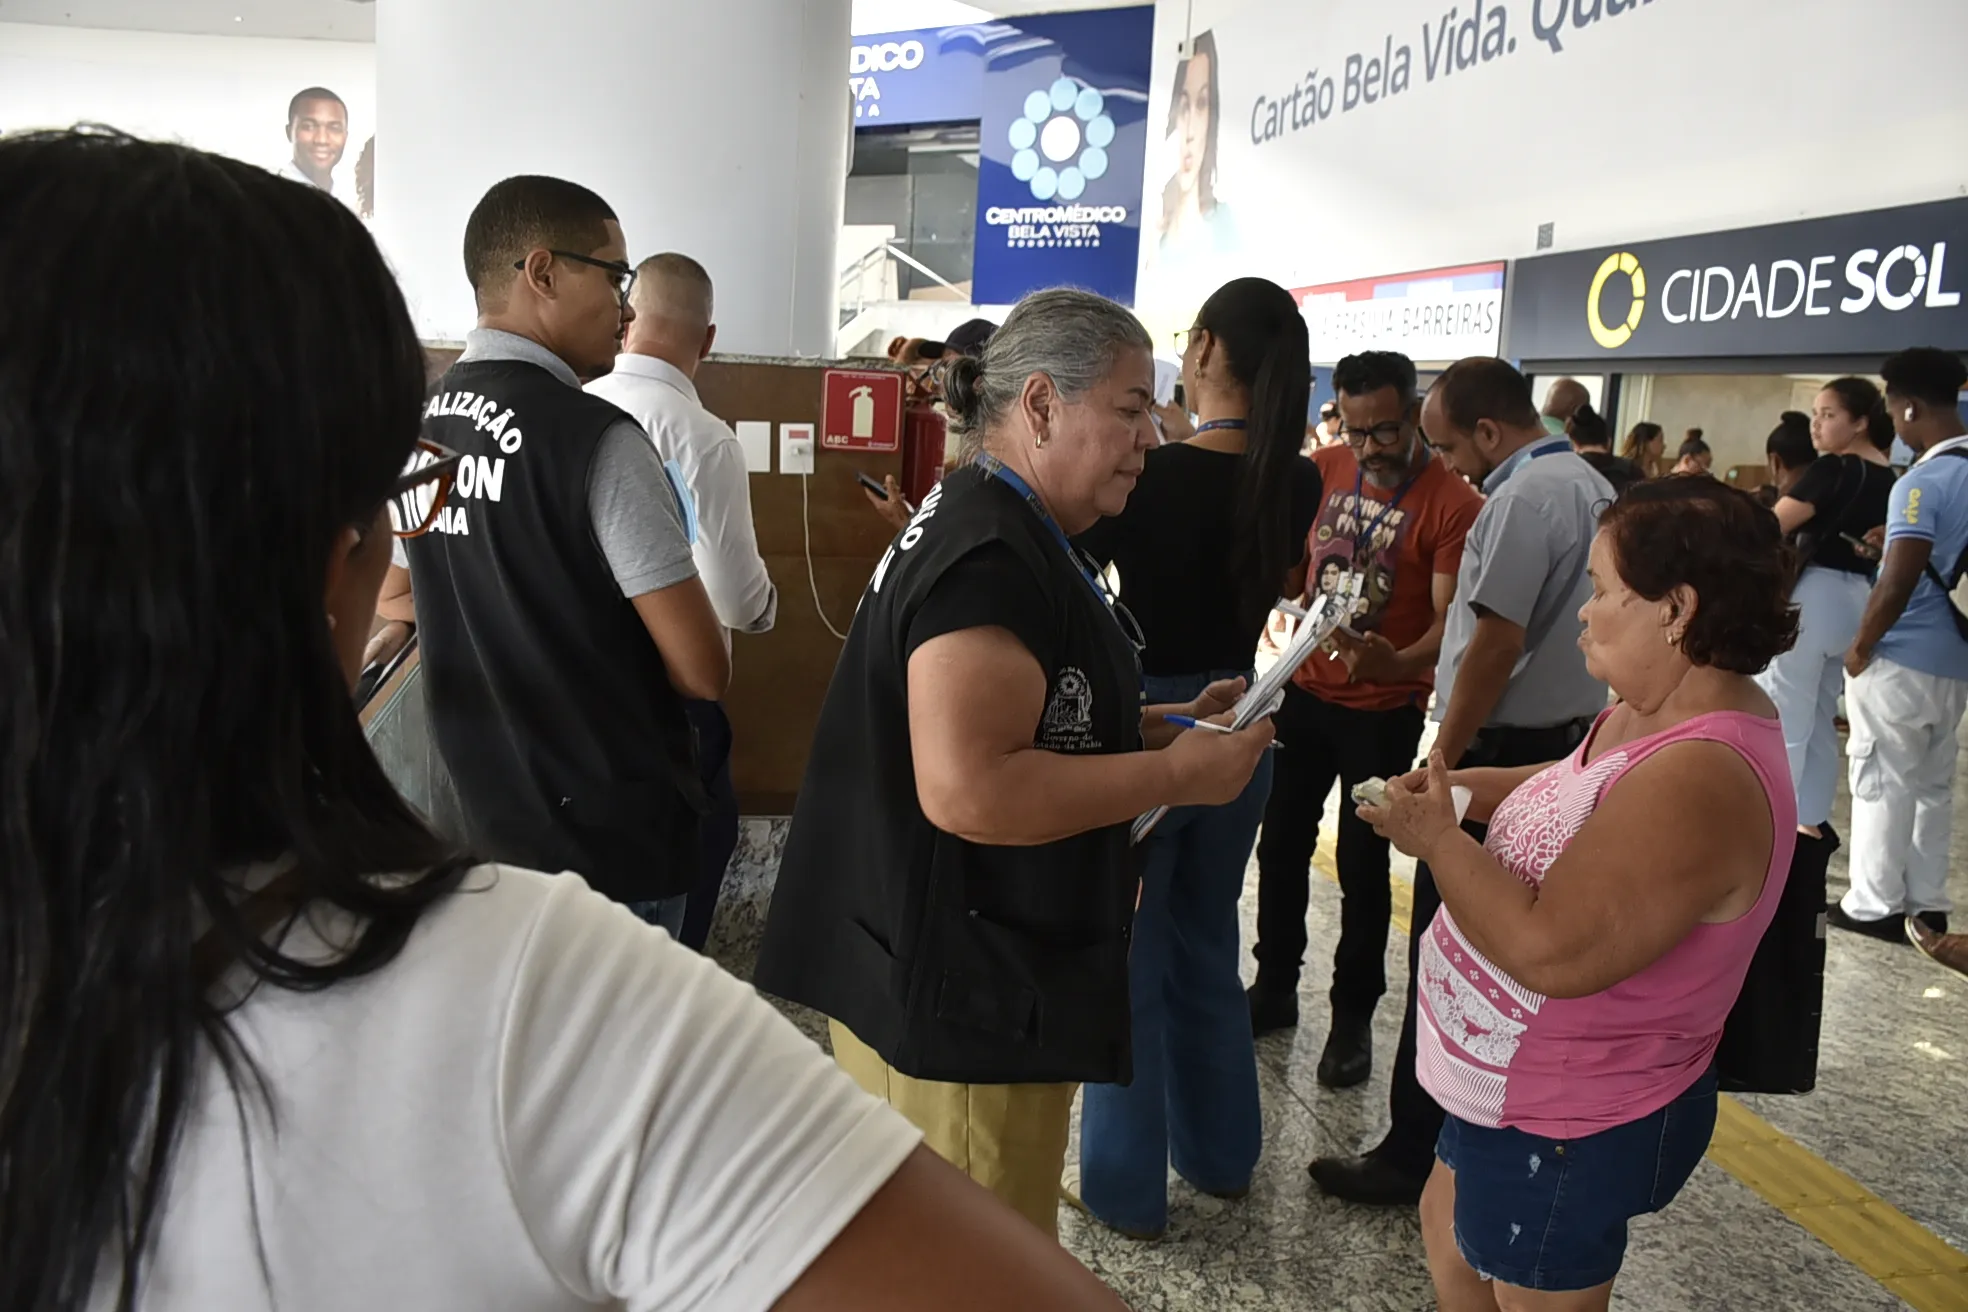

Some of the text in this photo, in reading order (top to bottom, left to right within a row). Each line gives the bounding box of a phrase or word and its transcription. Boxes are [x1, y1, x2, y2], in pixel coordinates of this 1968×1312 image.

[1251, 67, 1335, 145] Cartão
[1342, 34, 1412, 113] Bela
[1422, 0, 1517, 82] Vida.
[1008, 224, 1101, 239] BELA VISTA
[1402, 301, 1495, 337] BARREIRAS
[826, 434, 849, 445] ABC
